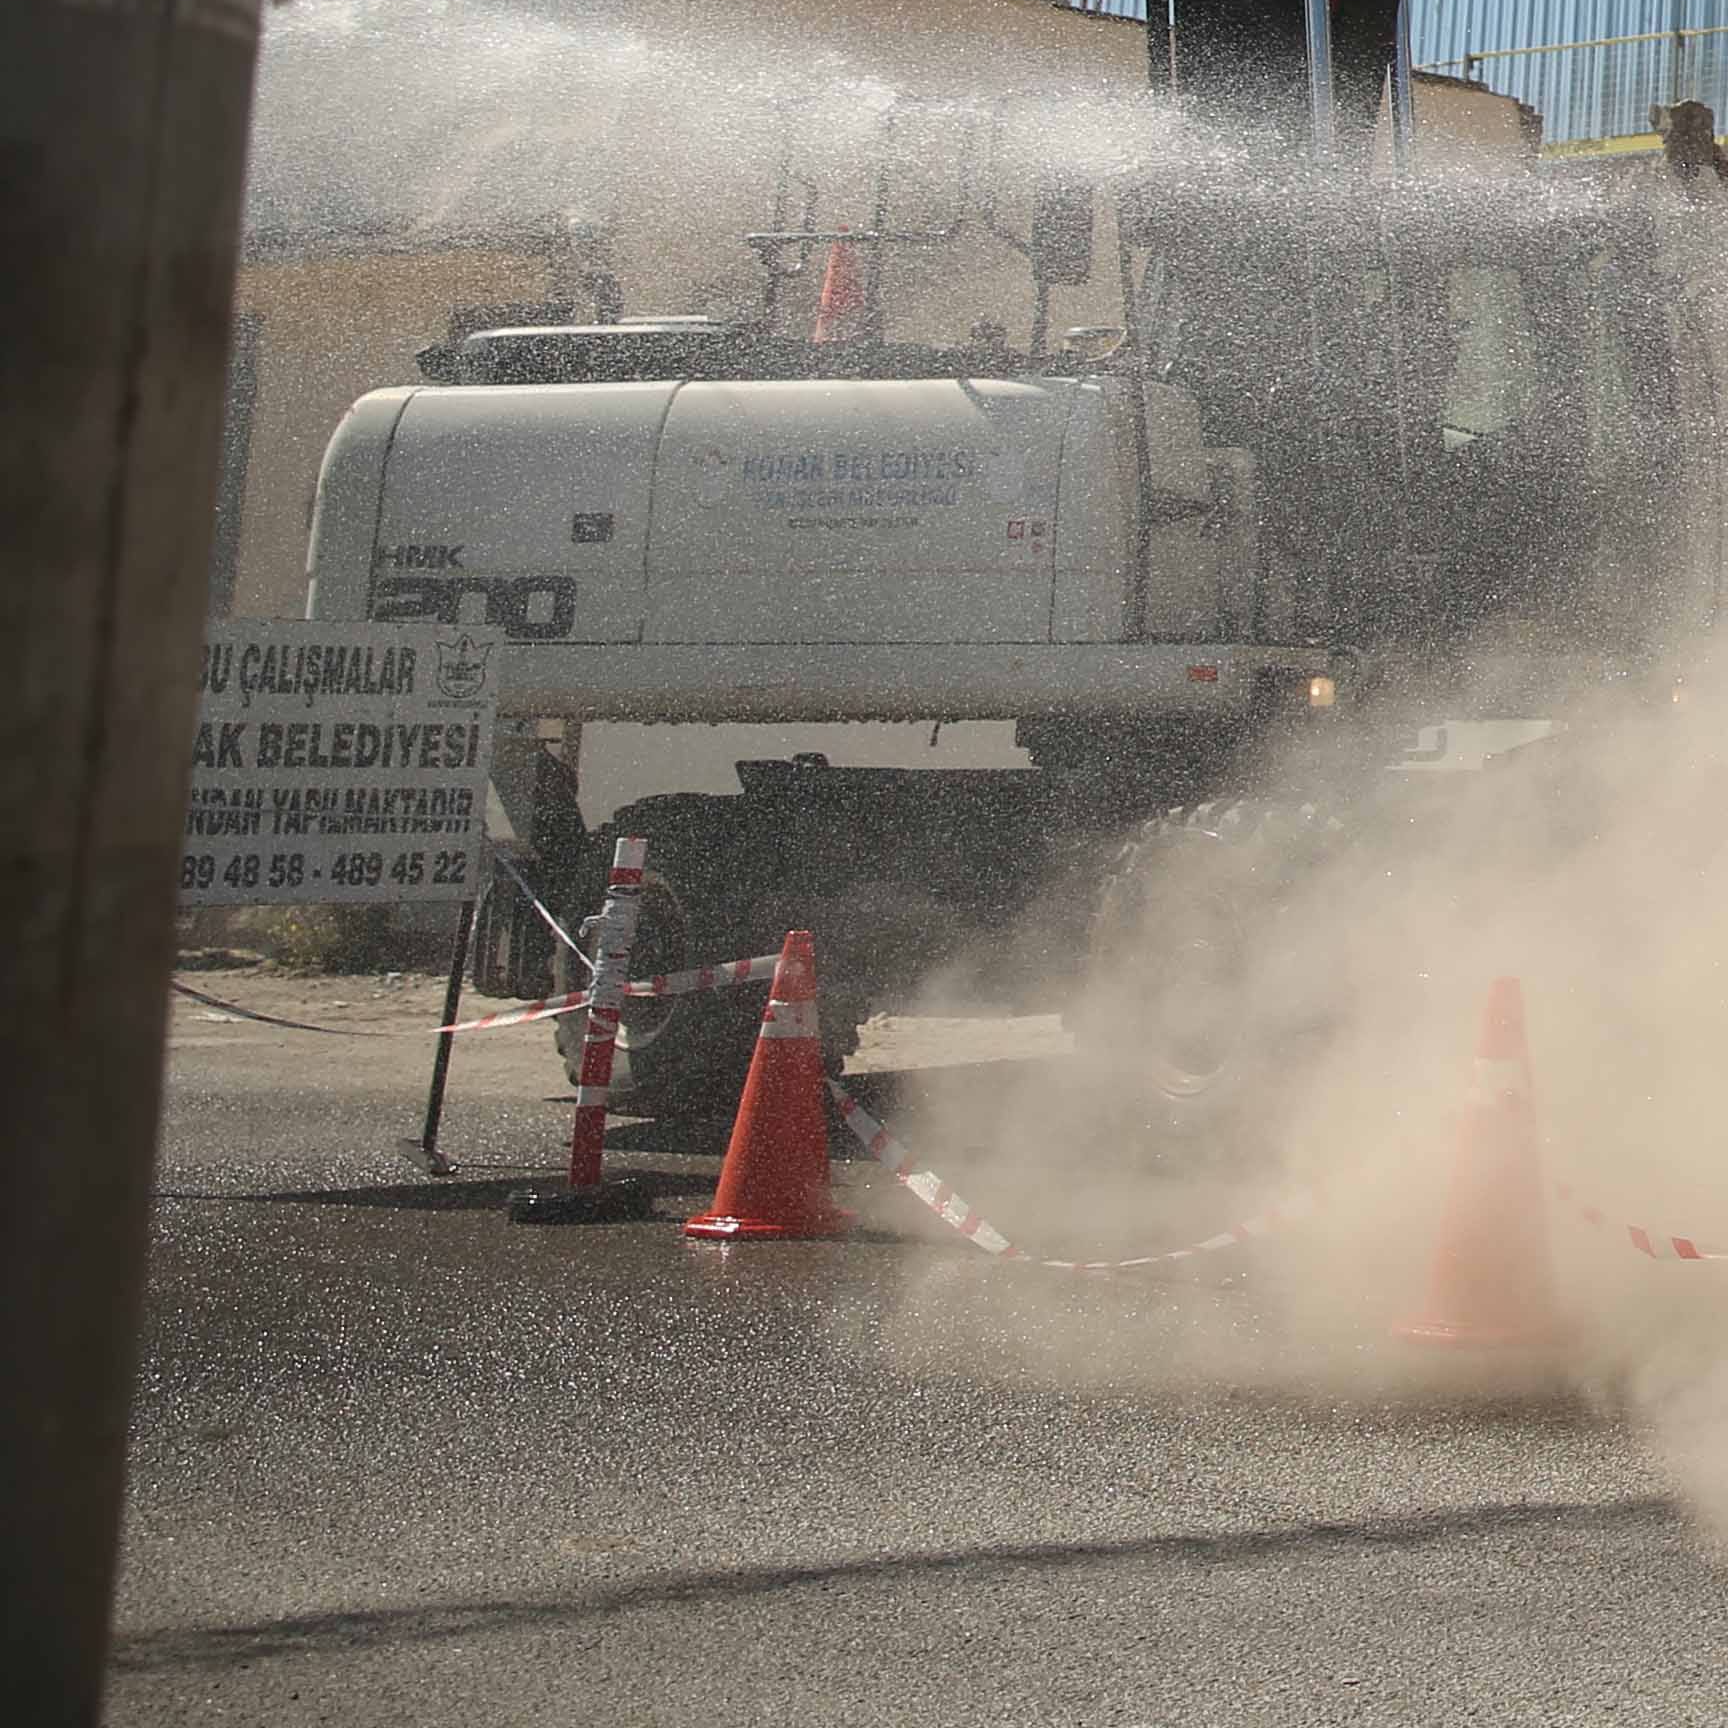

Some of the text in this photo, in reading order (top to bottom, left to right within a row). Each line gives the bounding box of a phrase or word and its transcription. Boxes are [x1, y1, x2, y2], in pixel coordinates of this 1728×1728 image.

[376, 545, 464, 569] HMK
[239, 643, 416, 709] ÇALIŞMALAR
[329, 851, 384, 886] 489
[391, 850, 425, 885] 45
[432, 849, 467, 884] 22
